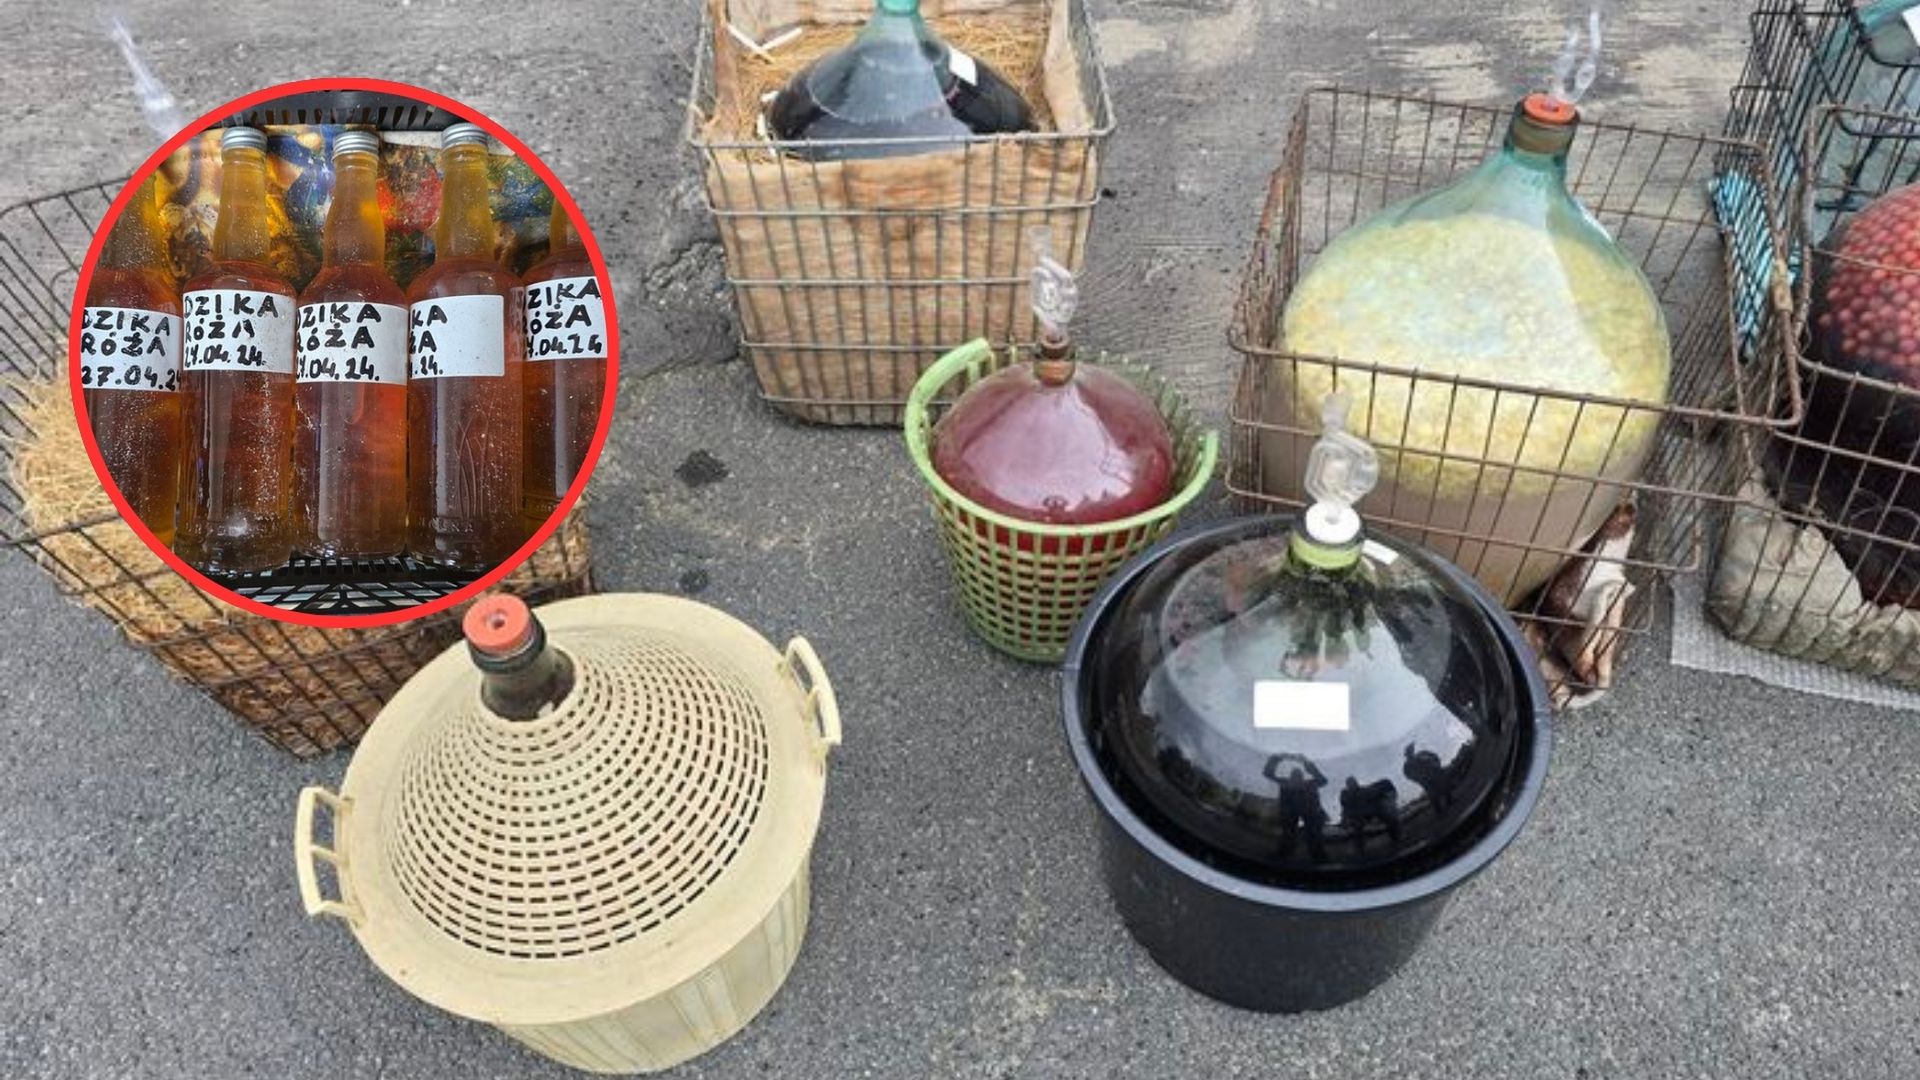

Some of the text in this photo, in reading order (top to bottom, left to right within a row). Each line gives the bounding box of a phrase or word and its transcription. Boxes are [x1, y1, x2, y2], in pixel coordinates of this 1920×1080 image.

[523, 278, 601, 304] ZIKA
[184, 293, 279, 319] DZIKA
[185, 315, 255, 344] RÓŻA
[81, 332, 166, 357] RÓŻA
[523, 333, 602, 359] 4.04.24
